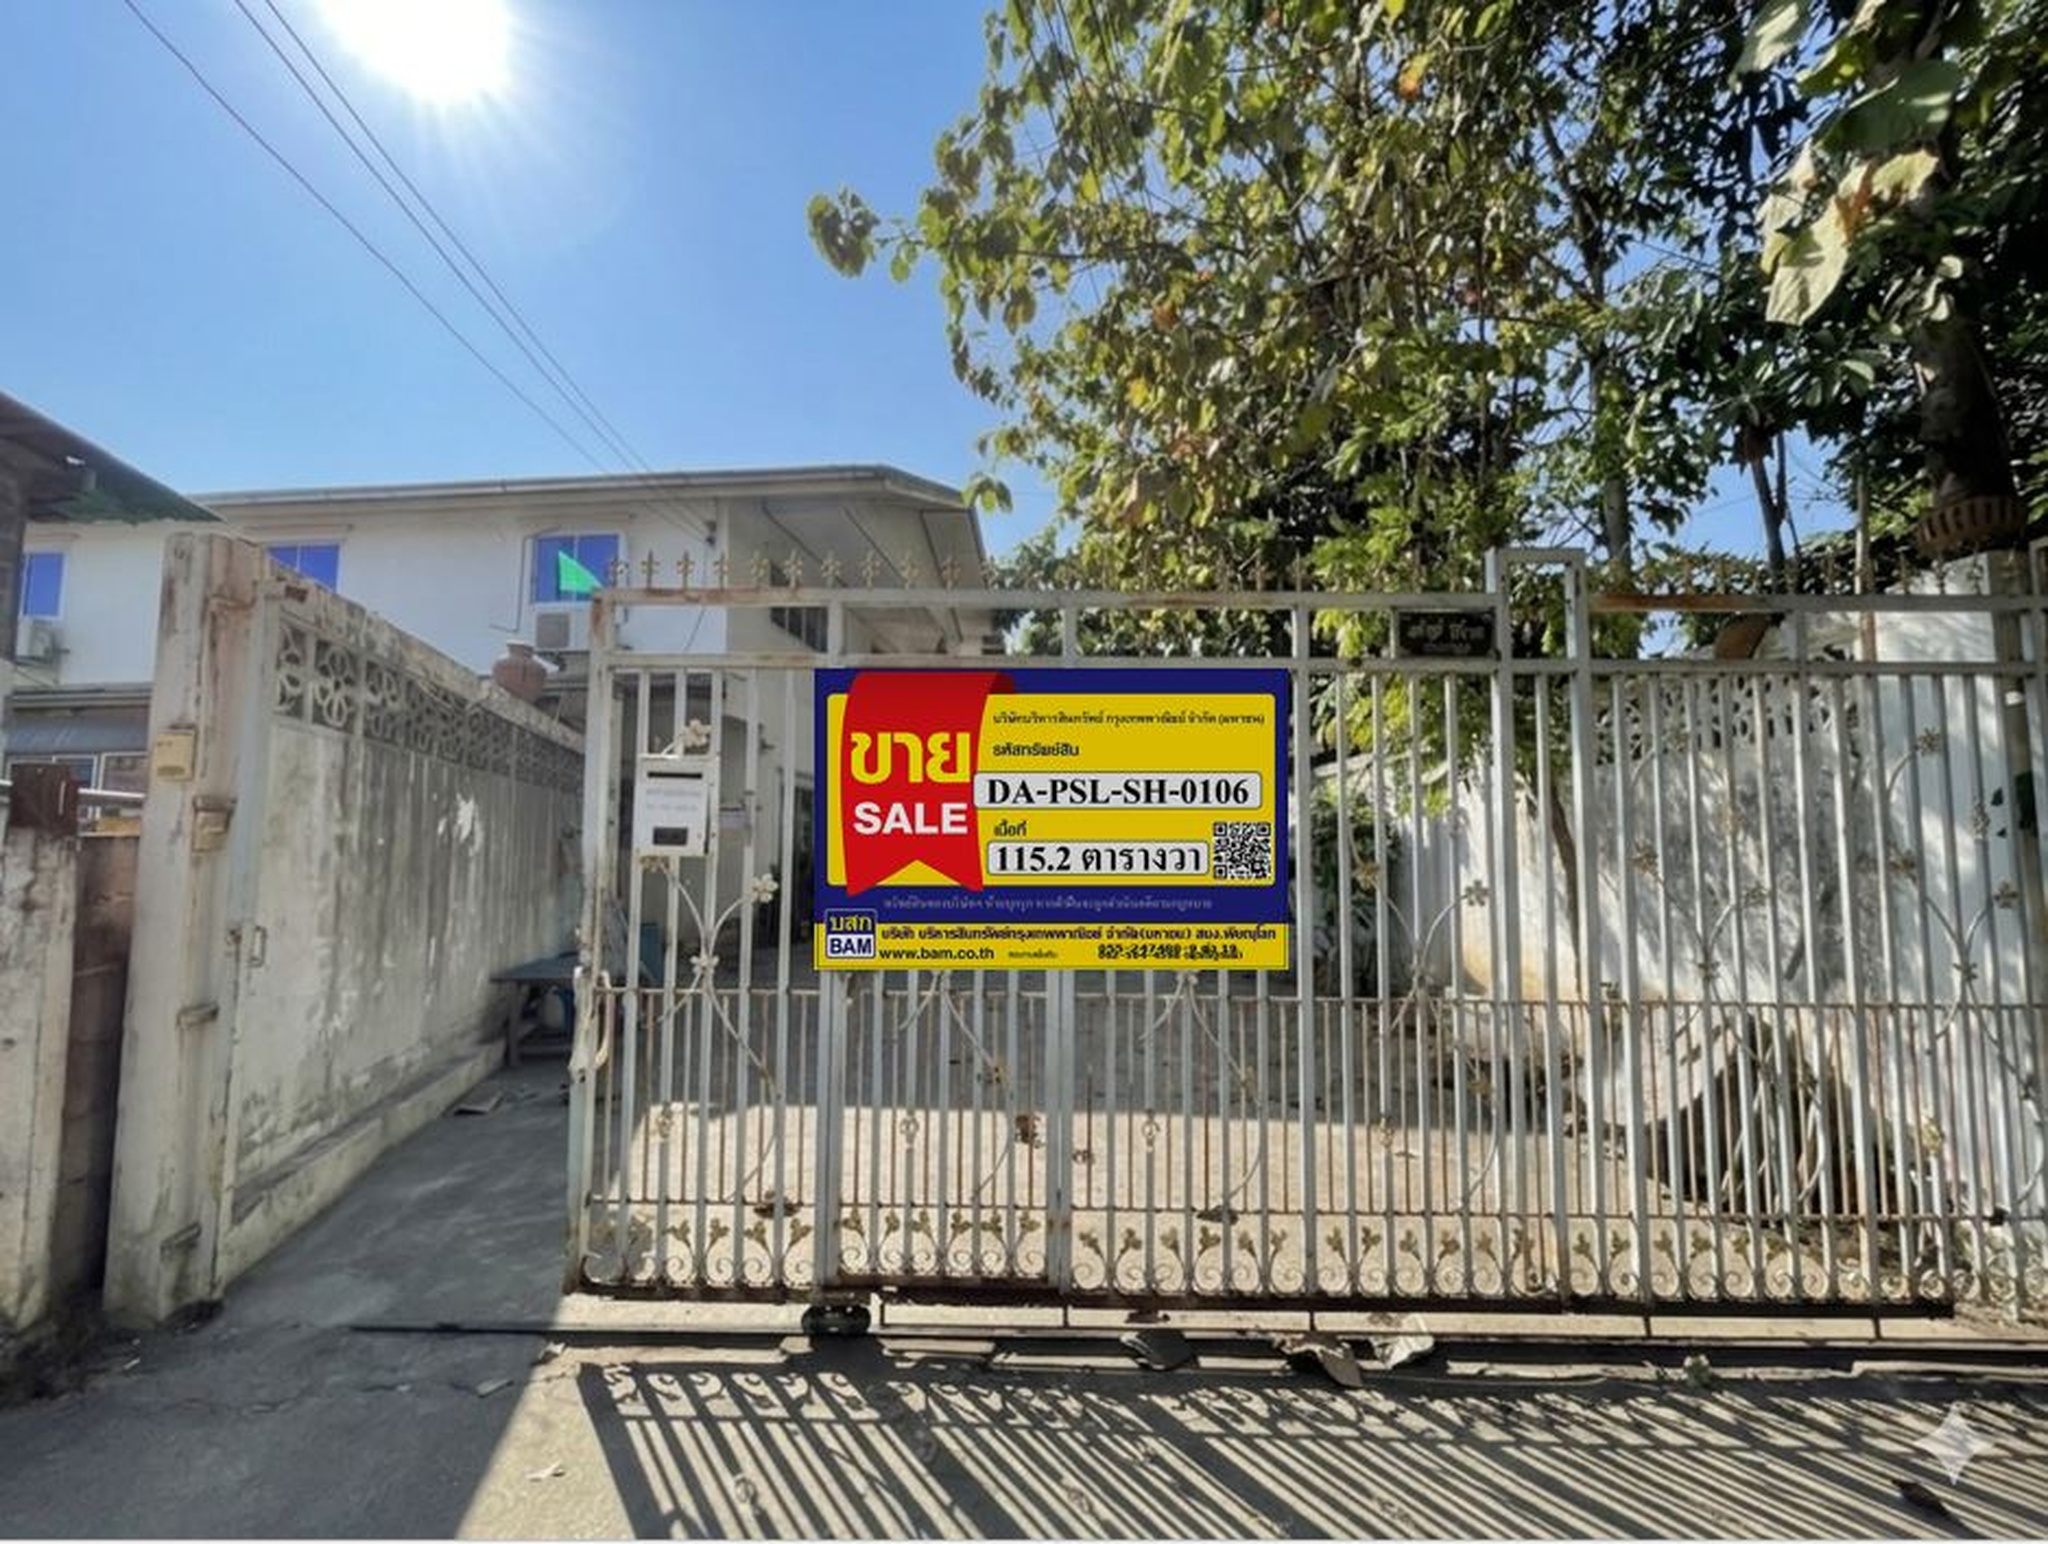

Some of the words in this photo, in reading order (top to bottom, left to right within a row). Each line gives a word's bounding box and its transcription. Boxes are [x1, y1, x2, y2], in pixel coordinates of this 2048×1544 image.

[850, 731, 971, 784] ขาย
[993, 742, 1080, 757] รหัสทรัพย์สิน
[988, 779, 1250, 805] DA-PSL-SH-0106
[853, 801, 969, 835] SALE
[993, 820, 1027, 837] เนื้อที่
[997, 846, 1071, 872] 115.2
[1081, 846, 1201, 872] ตารางวา
[829, 914, 873, 932] บสก
[830, 938, 872, 955] BAM
[879, 947, 995, 960] www.bam.co.th
